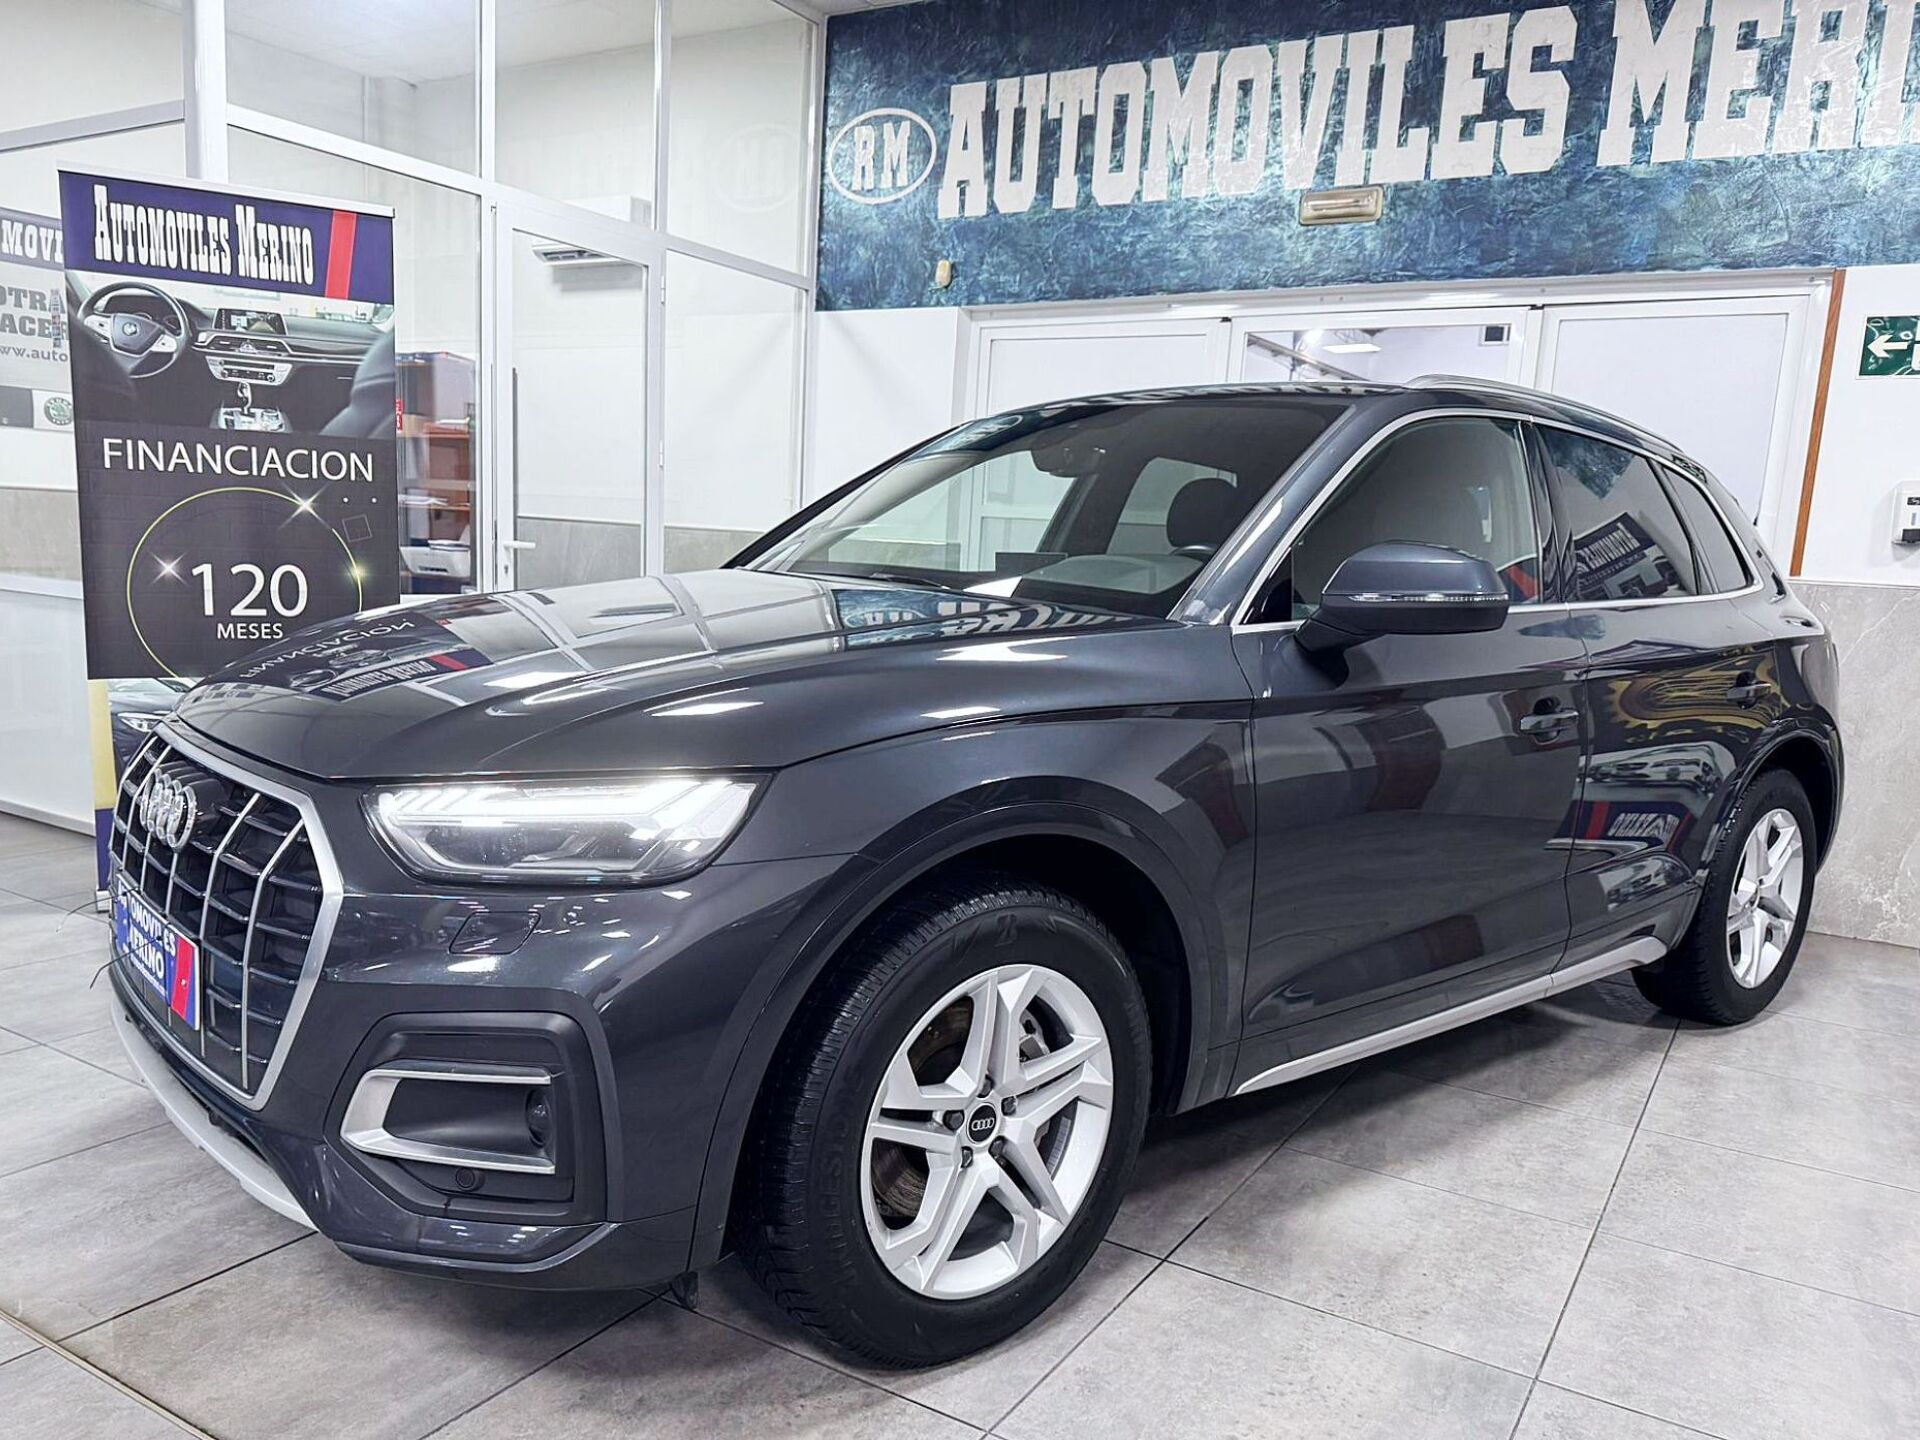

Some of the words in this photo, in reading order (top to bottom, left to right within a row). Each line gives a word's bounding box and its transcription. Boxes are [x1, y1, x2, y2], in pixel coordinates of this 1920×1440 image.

[937, 5, 1579, 220] AUTOMOVILES
[851, 119, 912, 191] RM
[94, 184, 232, 276] AUTOMOVILES
[235, 204, 314, 286] MERINO
[103, 437, 374, 482] FINANCIACION
[191, 562, 309, 618] 120
[216, 622, 284, 640] MESES
[117, 880, 176, 957] OMOVILES
